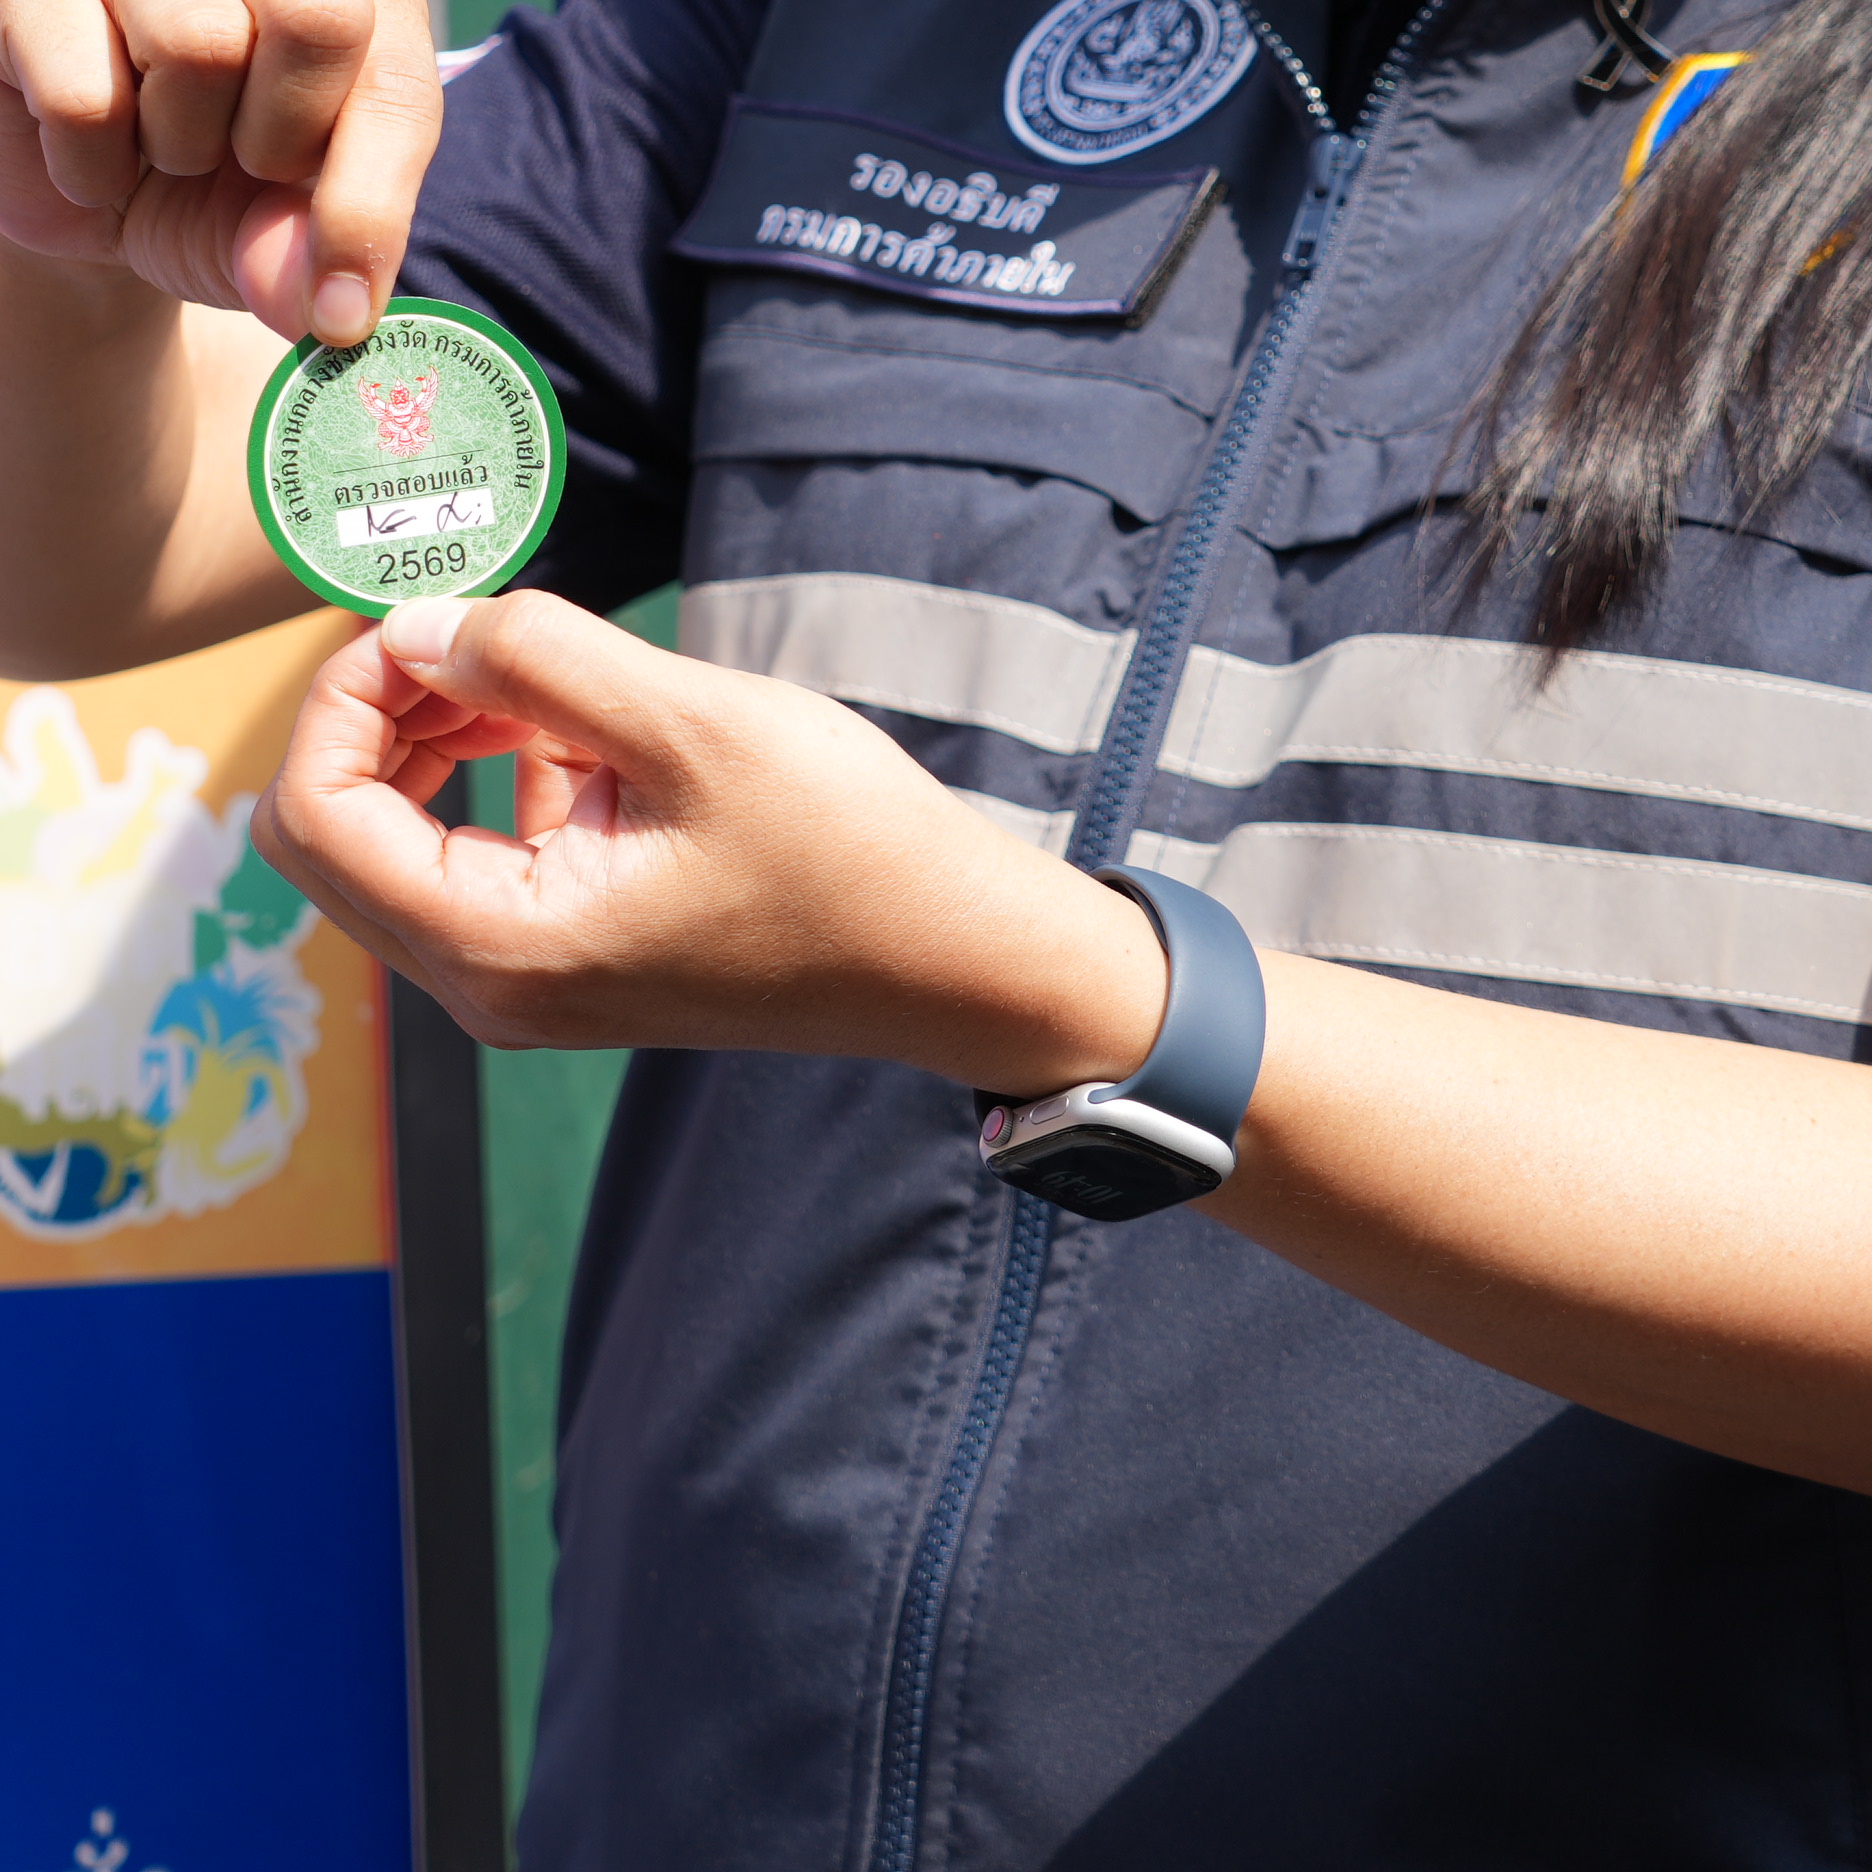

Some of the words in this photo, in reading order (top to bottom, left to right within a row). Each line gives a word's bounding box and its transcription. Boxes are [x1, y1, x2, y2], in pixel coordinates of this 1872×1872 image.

[849, 153, 1061, 234] รองอธิบดี
[756, 204, 1077, 296] กรมการค้าภายใน
[272, 319, 427, 525] สำนักงานกลางชังตวงวัด
[434, 334, 545, 490] กรมการค้าภายใน
[333, 454, 489, 505] ตรวจสอบแล้ว
[377, 542, 467, 585] 2569
